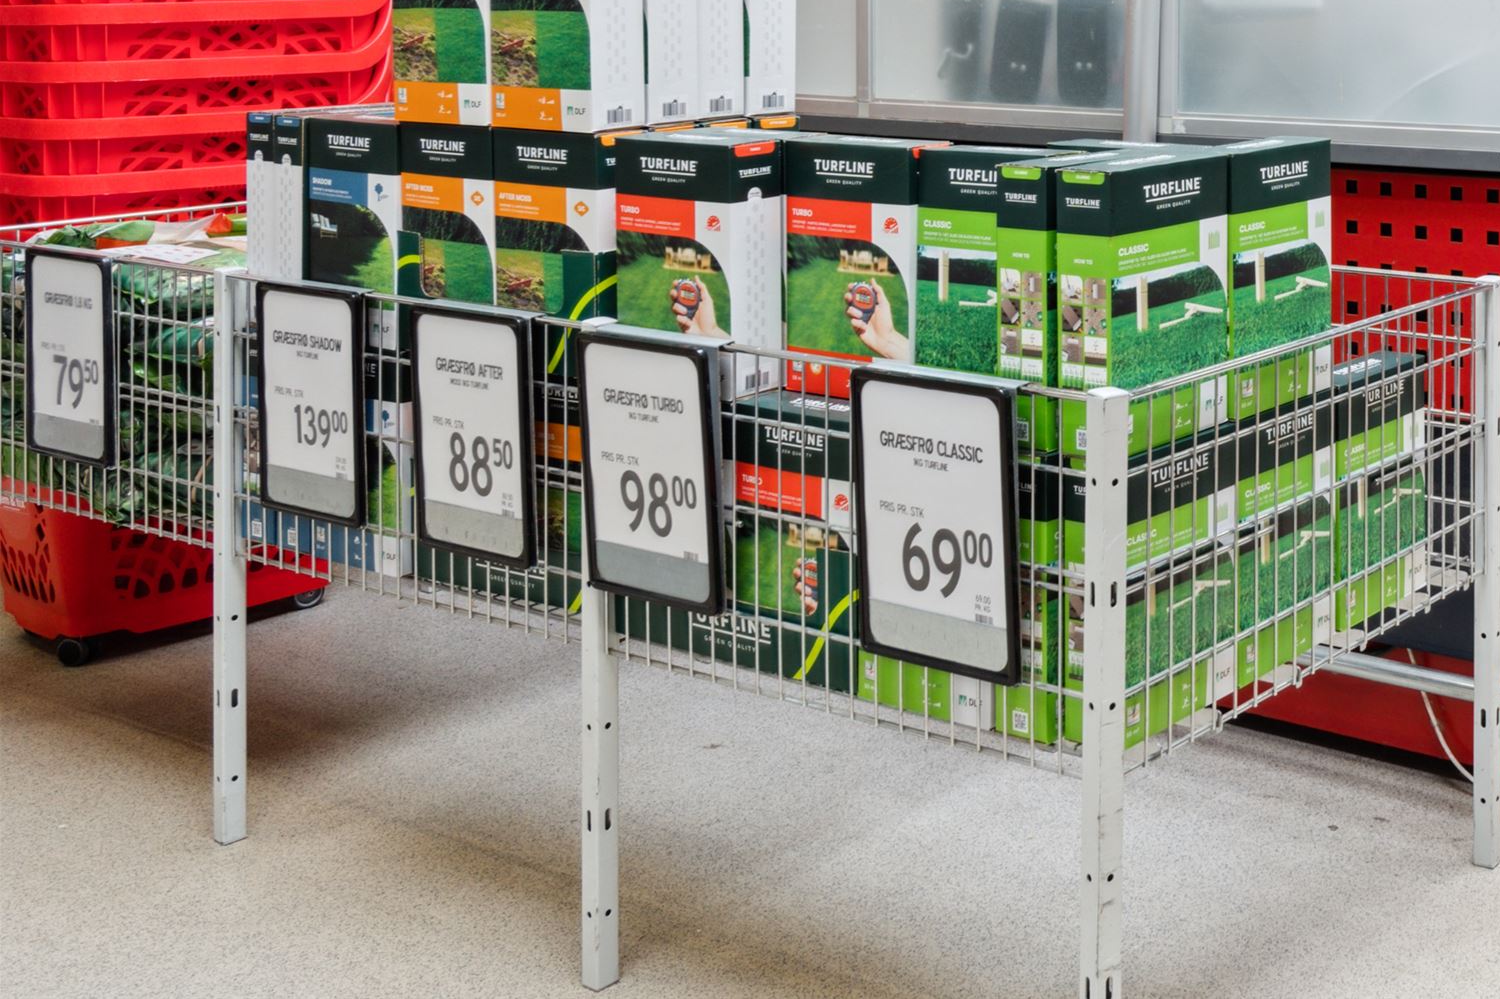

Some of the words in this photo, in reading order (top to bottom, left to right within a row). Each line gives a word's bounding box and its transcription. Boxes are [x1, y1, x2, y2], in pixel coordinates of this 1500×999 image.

[250, 133, 269, 141] TURFLINE
[277, 136, 297, 145] TURFLINE
[327, 134, 370, 148] TURFLINE
[420, 138, 466, 152] TURFLINE
[517, 146, 568, 161] TURFLINE
[640, 156, 697, 173] TURFLINE
[739, 165, 772, 177] TURFLINE
[814, 158, 875, 174] TURFLINE
[1260, 160, 1309, 180] TURFLINE
[312, 176, 333, 186] SHADOW
[948, 167, 998, 182] TURFLI
[405, 182, 418, 191] AFTER
[1143, 177, 1202, 199] TURFLINE
[499, 191, 515, 201] AFTER
[516, 193, 532, 203] MOSS
[1004, 192, 1037, 203] TURFLINE
[1065, 197, 1100, 208] TURFLINE
[620, 204, 641, 215] TURBO
[792, 207, 813, 218] TURBO
[923, 219, 952, 230] CLASSIC
[1239, 221, 1266, 234] CLASSIC
[1118, 243, 1149, 257] CLASSIC
[273, 329, 308, 348] GRÆSFRØ
[309, 335, 342, 352] SHADOW
[436, 357, 475, 377] GRÆSFRØ
[478, 363, 503, 381] AFTER
[603, 387, 648, 409] GRÆSFRØ
[650, 395, 684, 414] TURBO
[764, 425, 824, 447] TURFLNE
[879, 430, 934, 454] GRÆSFRØ
[936, 440, 984, 464] CLASSIC
[924, 459, 949, 472] TURFLINE
[879, 500, 895, 513] PRIS
[910, 504, 925, 519] STK
